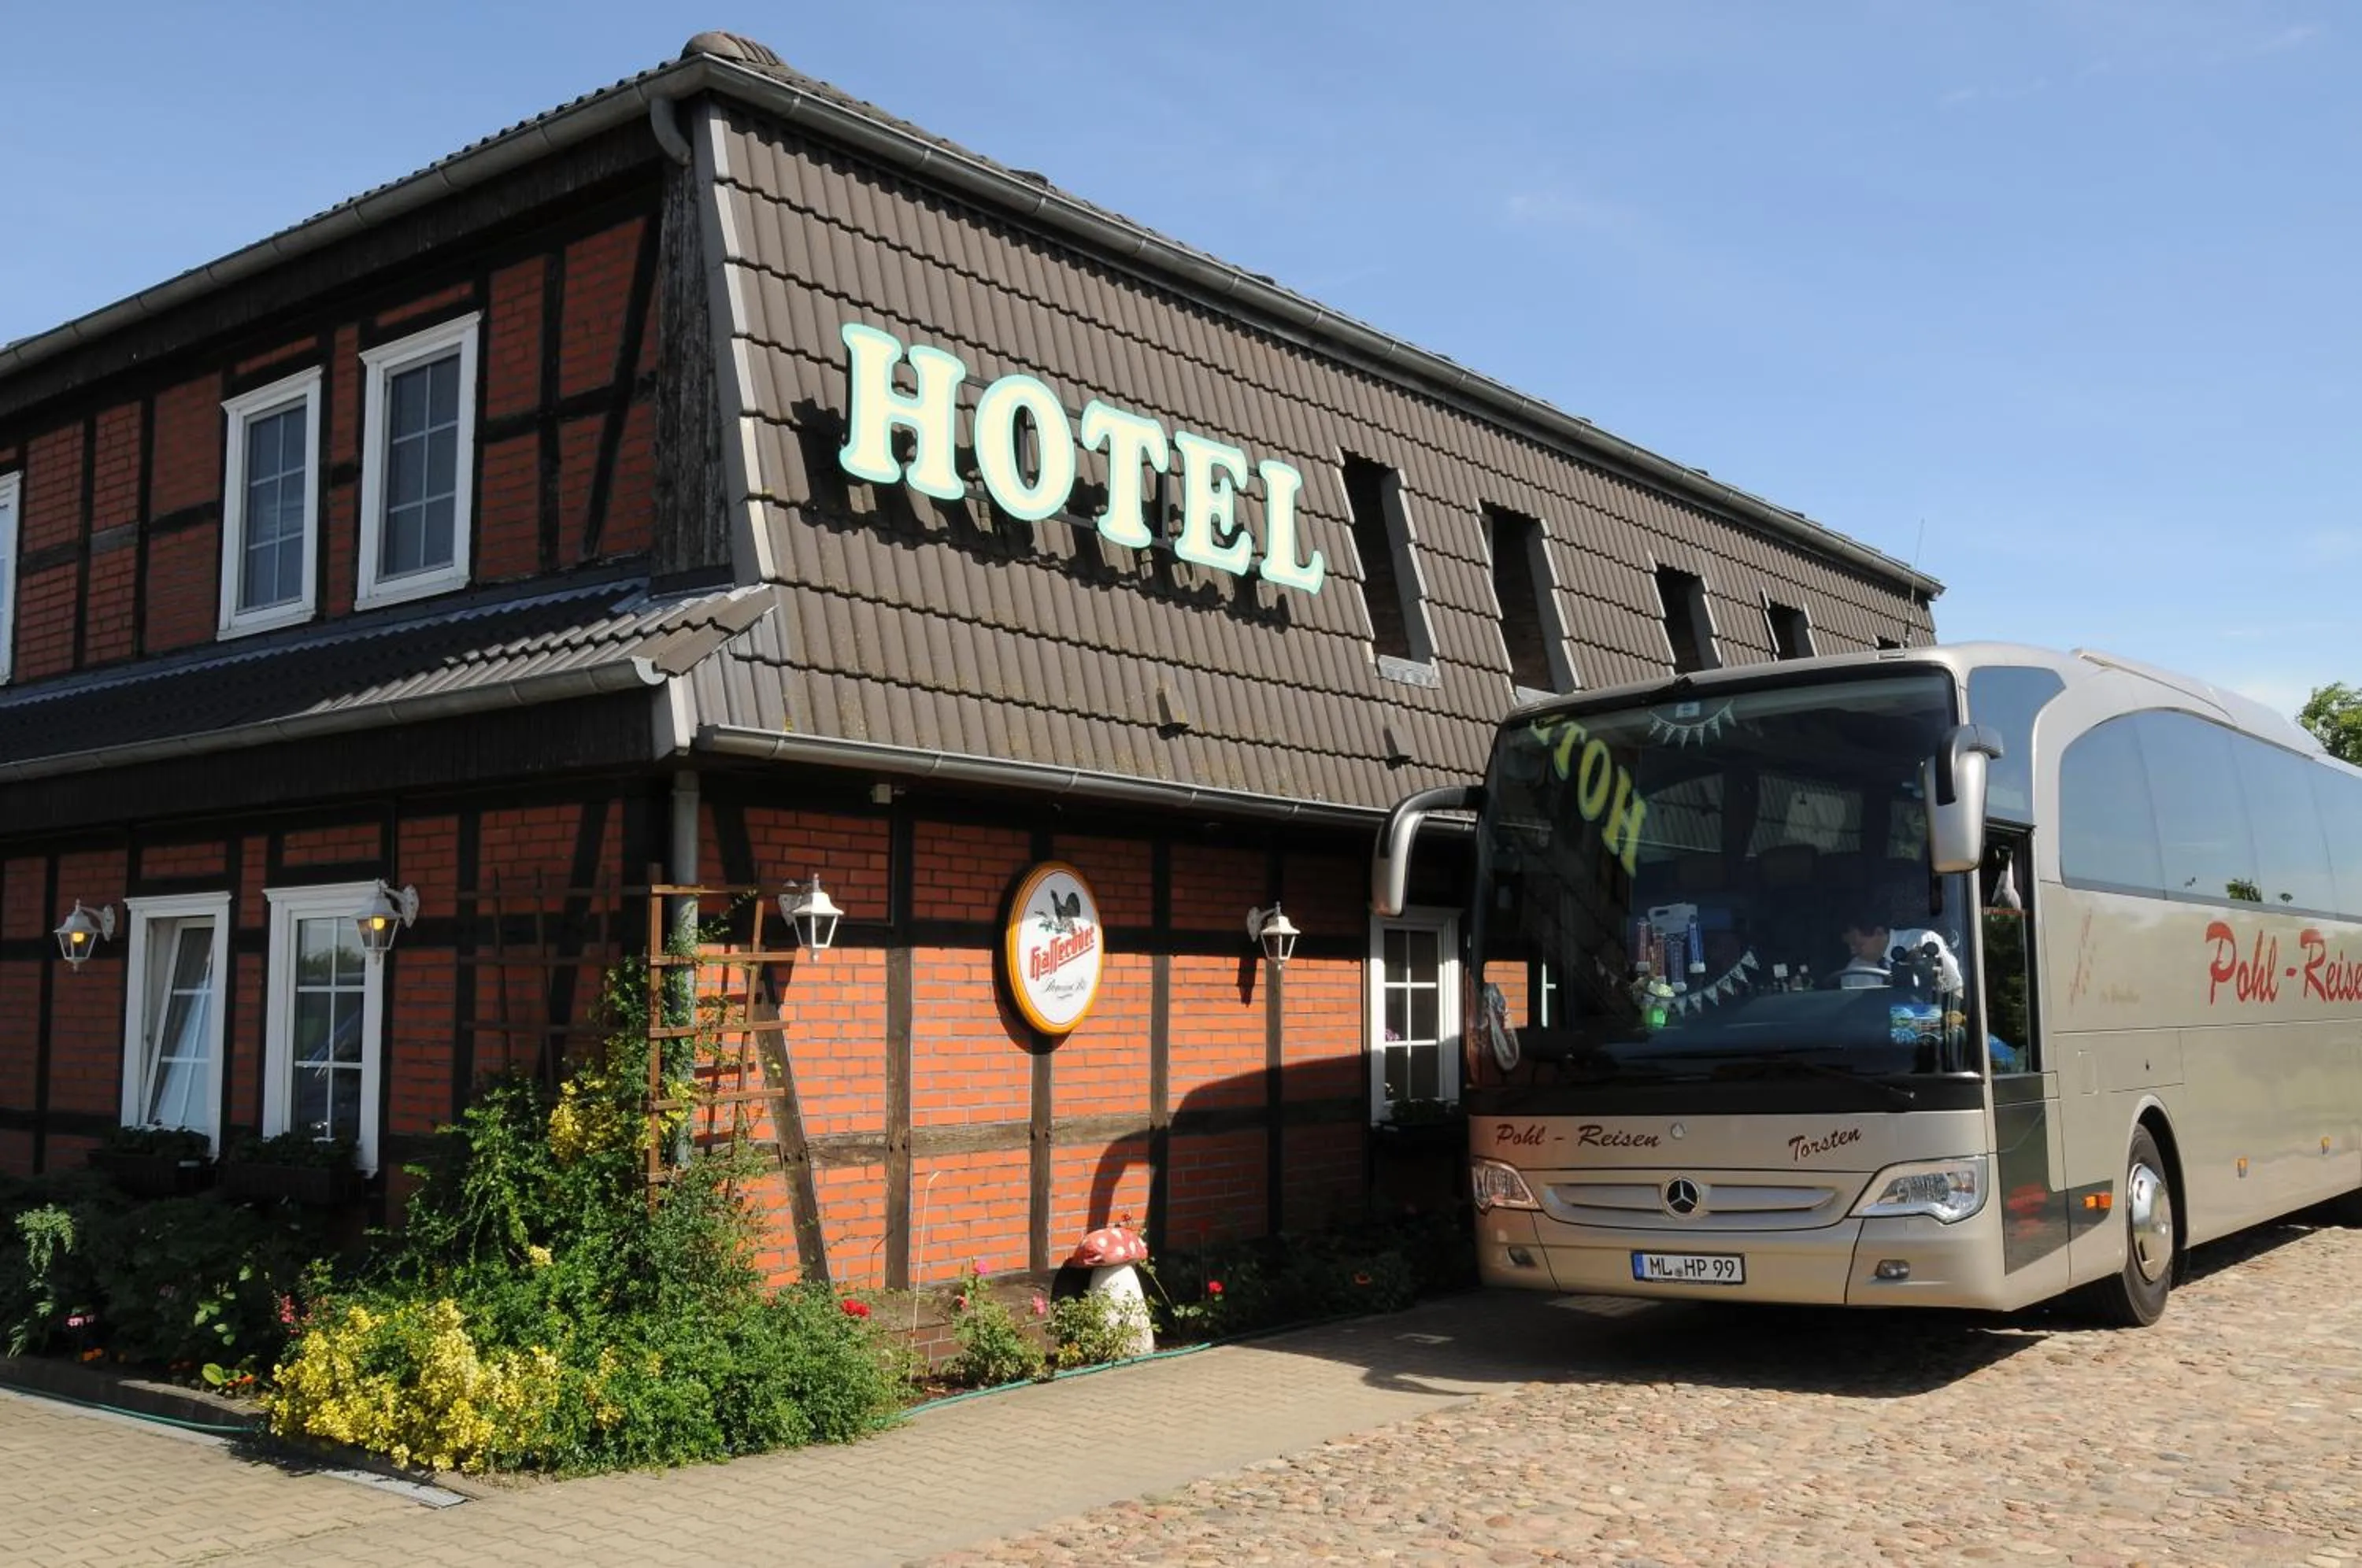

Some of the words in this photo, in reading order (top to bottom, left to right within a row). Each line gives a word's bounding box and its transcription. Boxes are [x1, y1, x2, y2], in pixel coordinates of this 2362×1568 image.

[840, 323, 1324, 594] HOTEL
[2205, 921, 2279, 1005] Pohl
[1496, 1123, 1546, 1145] Pohl
[1577, 1123, 1662, 1148] Reisen
[1788, 1128, 1861, 1162] Torsten
[1649, 1257, 1673, 1276] ML
[1684, 1259, 1708, 1277] HP
[1712, 1259, 1735, 1278] 99
